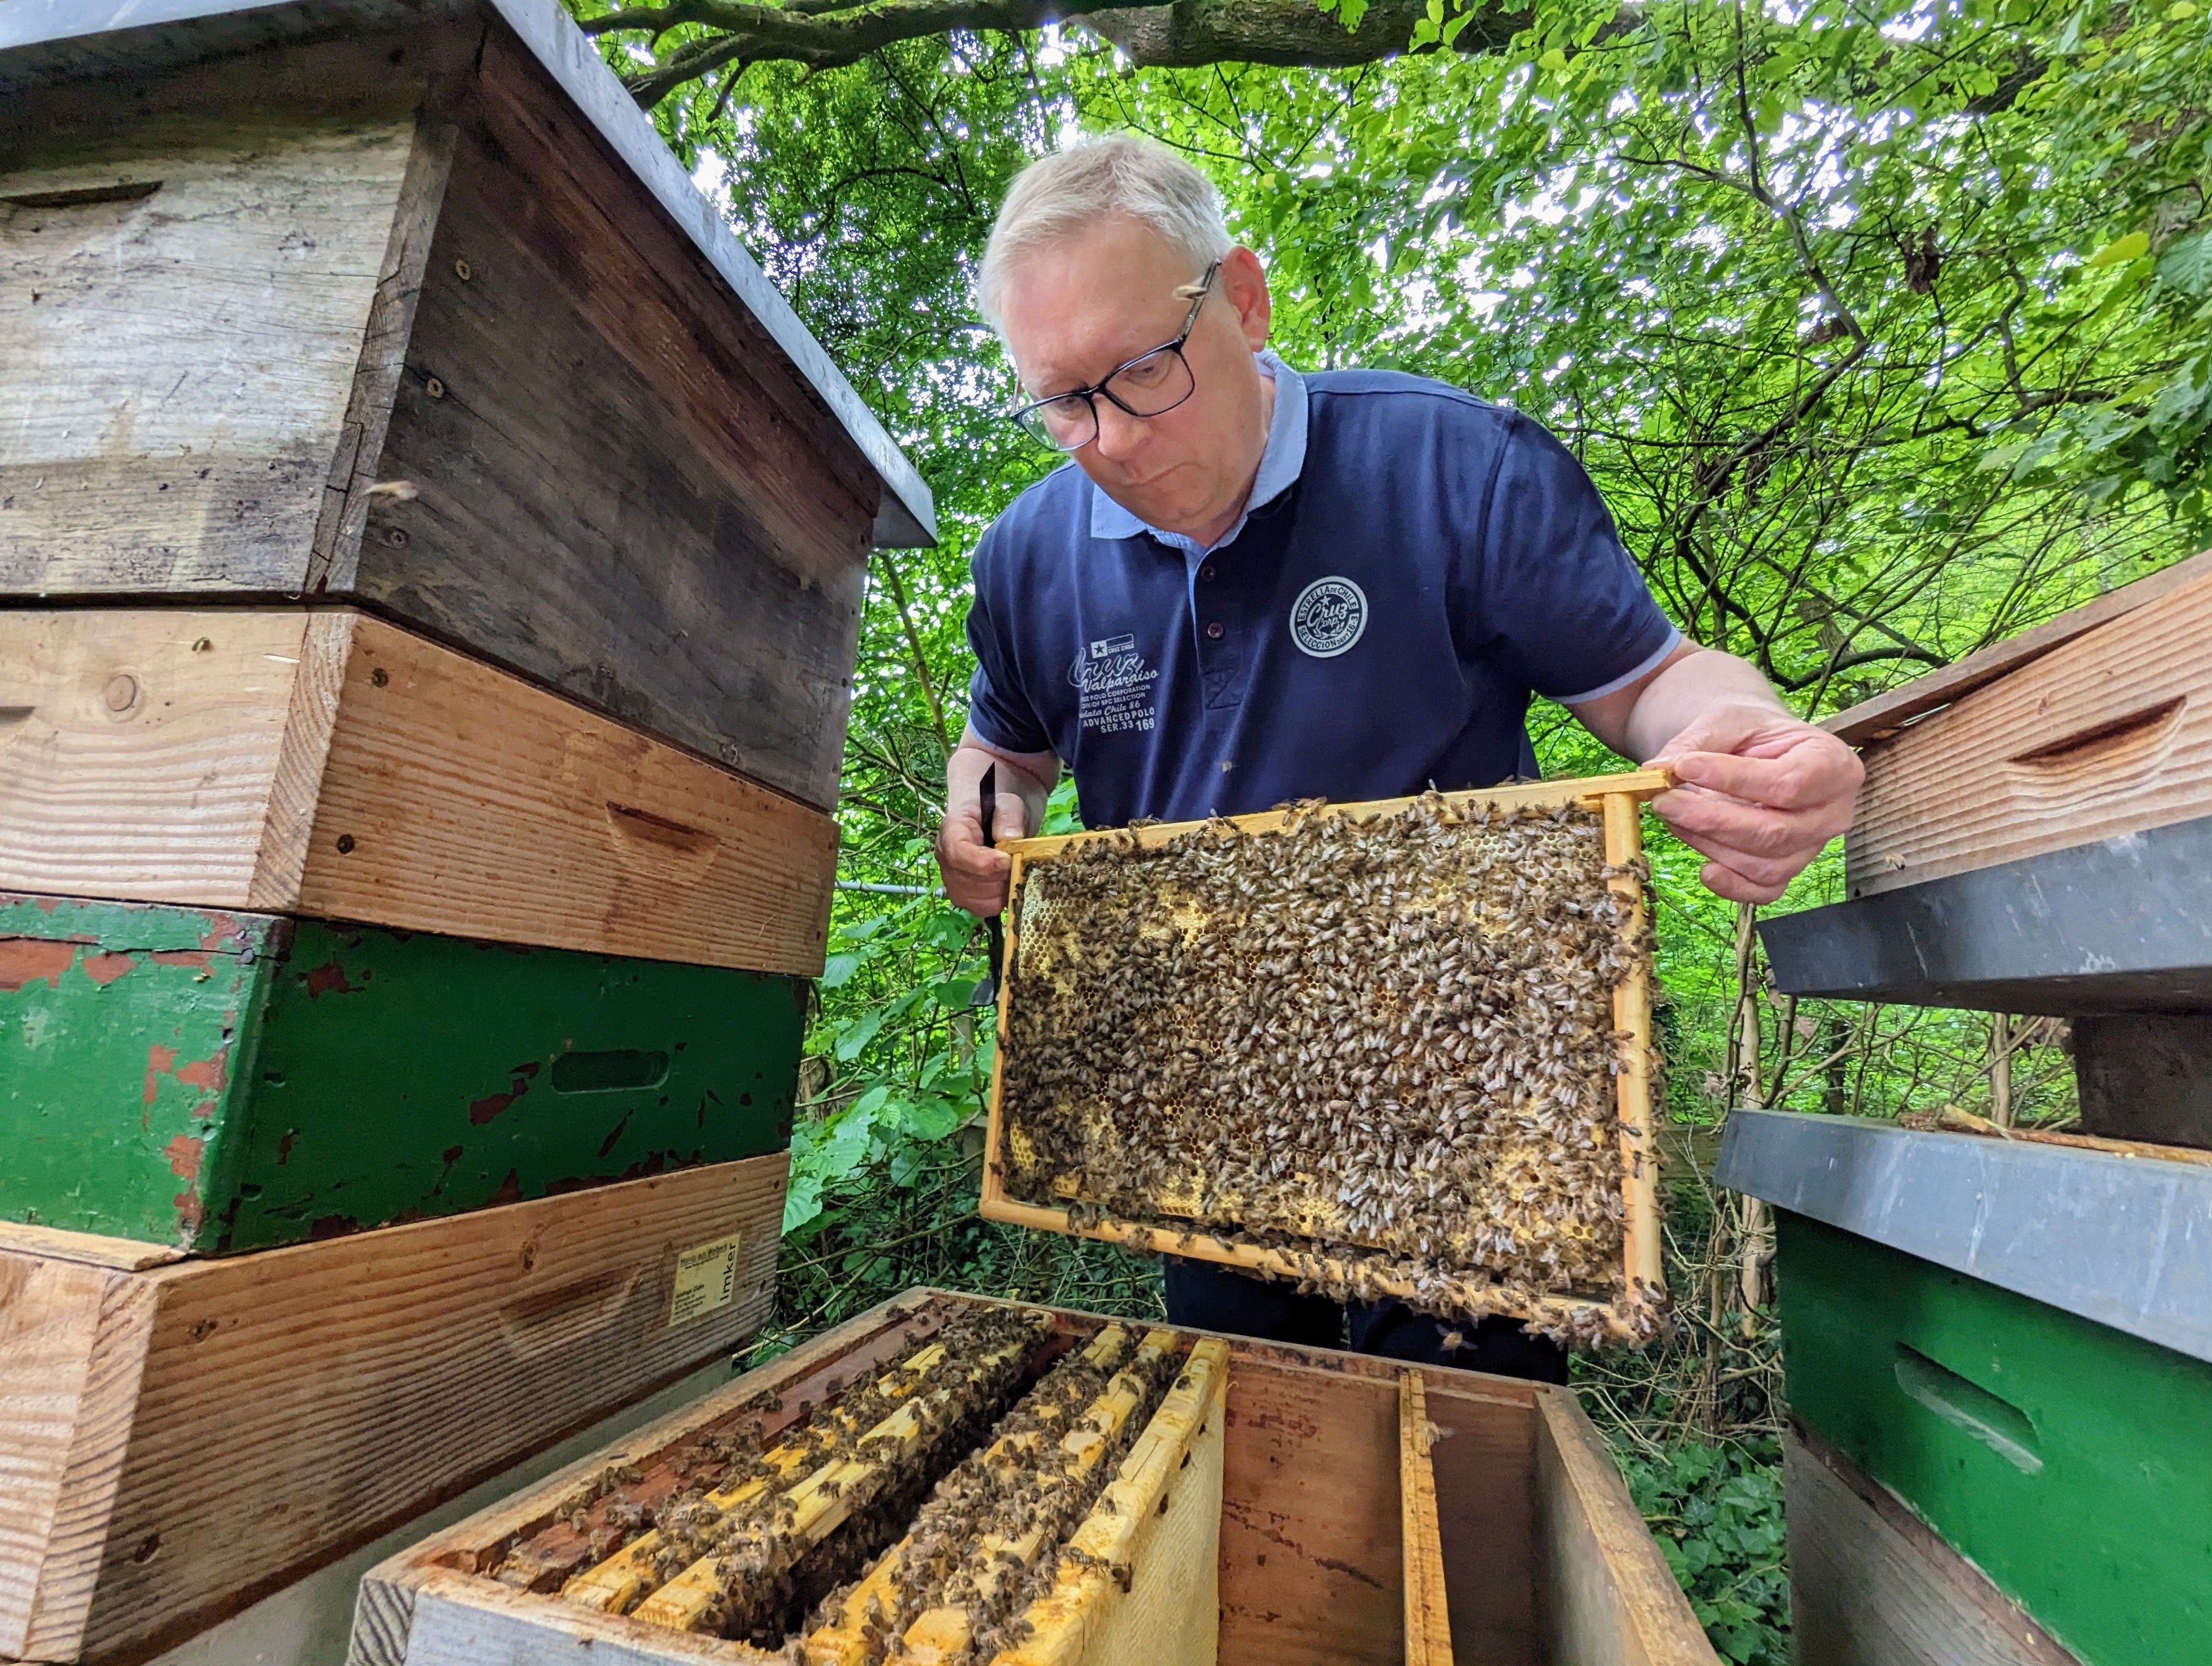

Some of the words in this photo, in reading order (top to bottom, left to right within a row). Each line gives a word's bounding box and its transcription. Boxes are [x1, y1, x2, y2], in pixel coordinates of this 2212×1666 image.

[1298, 586, 1330, 619] ESTRELLA
[1338, 587, 1357, 608] CHILE
[1307, 603, 1347, 627] Cruz
[1300, 628, 1336, 648] SELECCION
[1107, 684, 1150, 697] CORPORATION
[1083, 712, 1130, 728] ADVANCED
[1131, 707, 1155, 719] POLO
[1104, 704, 1127, 716] Chile
[1136, 718, 1155, 731] 169
[720, 1243, 736, 1300] Imker
